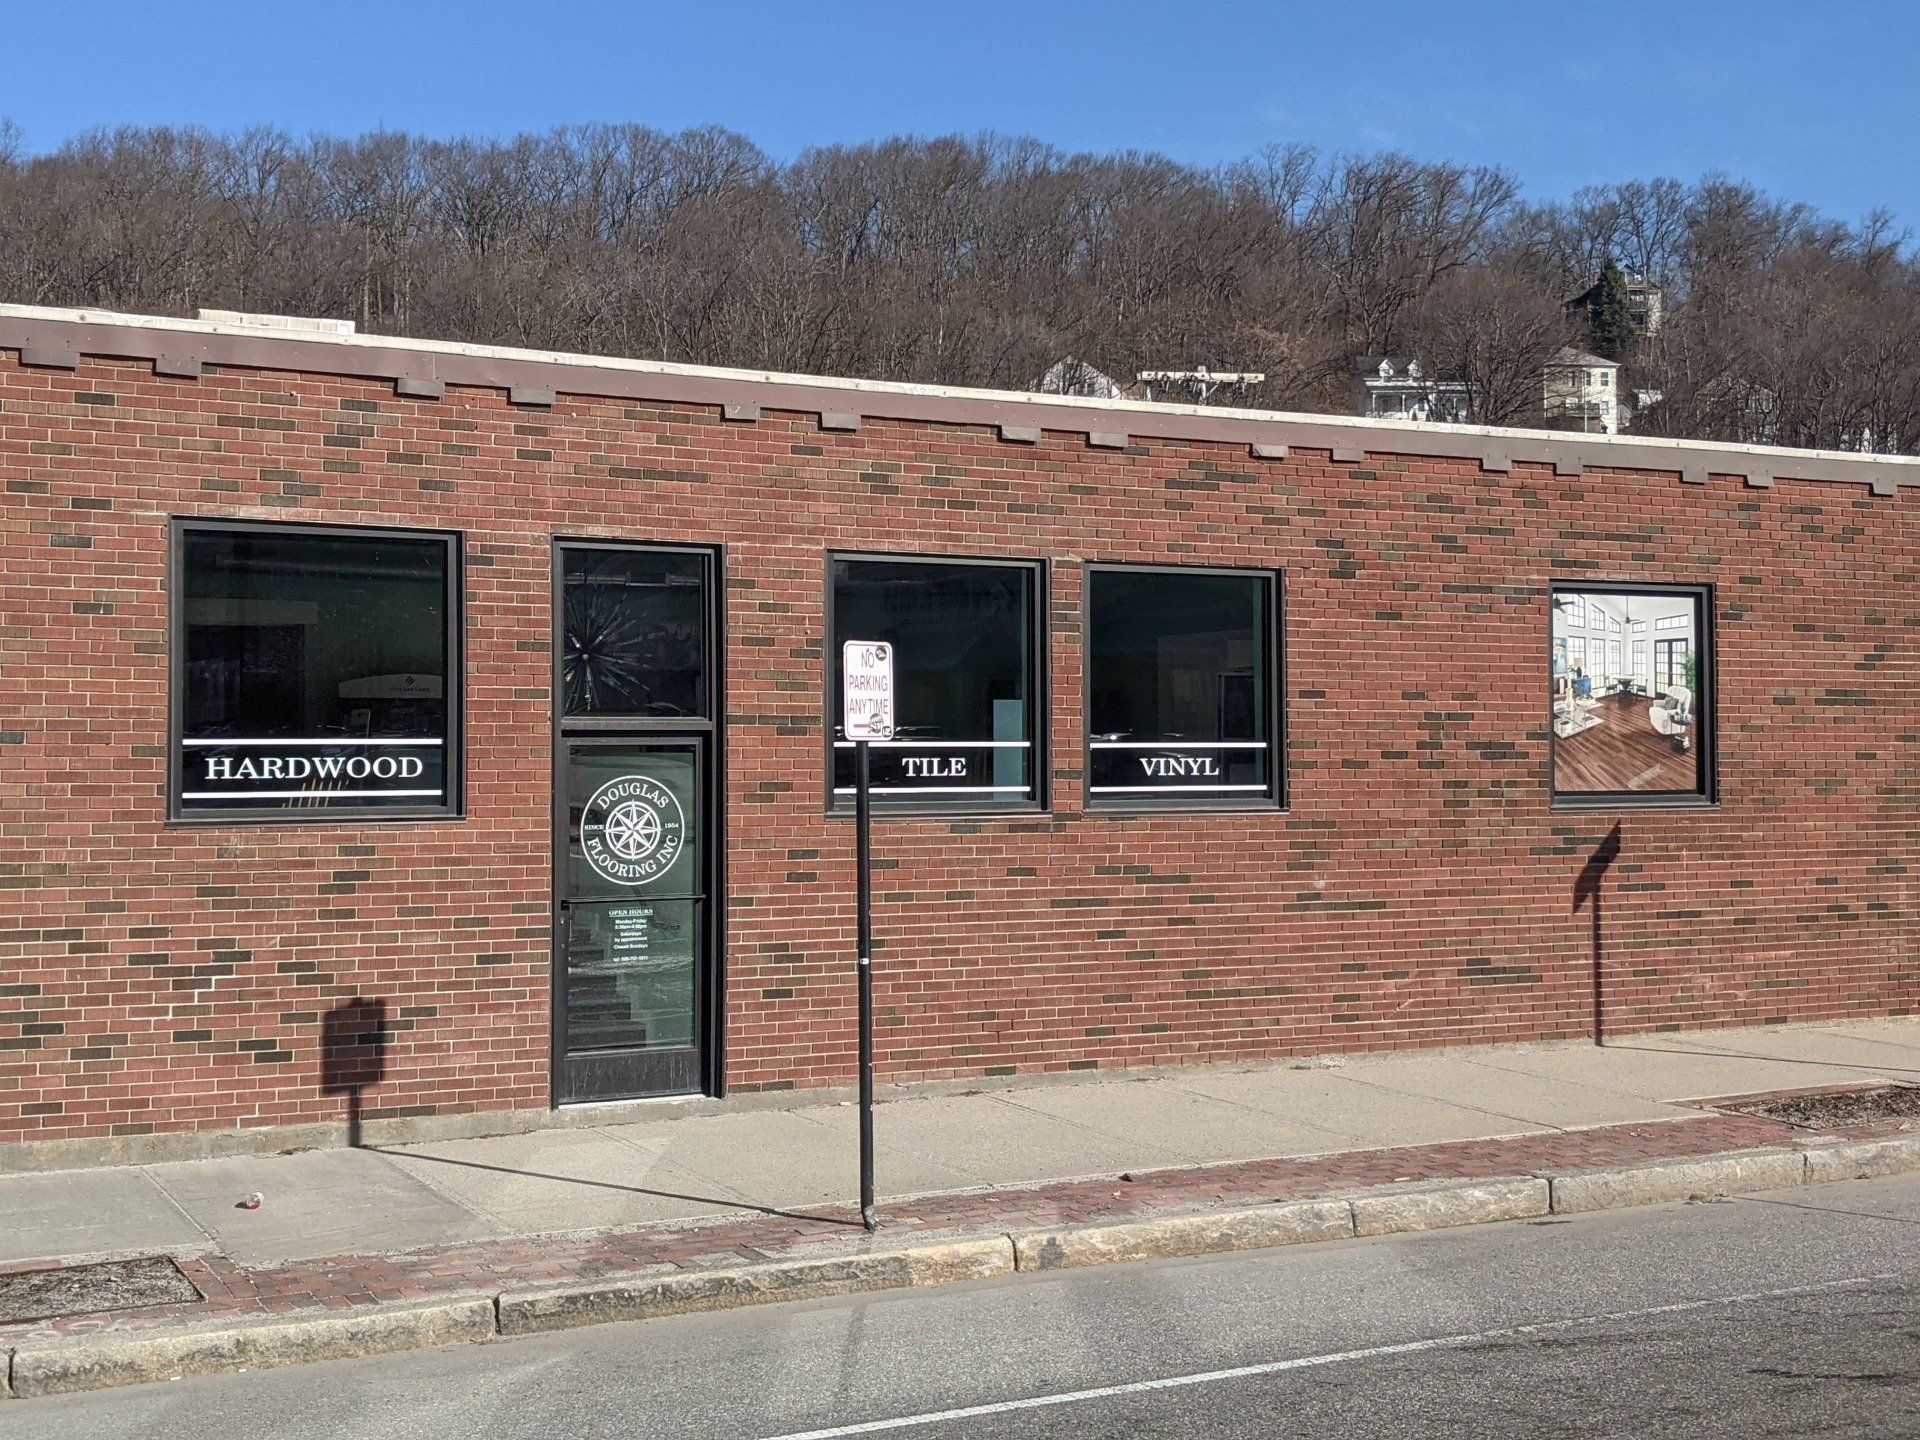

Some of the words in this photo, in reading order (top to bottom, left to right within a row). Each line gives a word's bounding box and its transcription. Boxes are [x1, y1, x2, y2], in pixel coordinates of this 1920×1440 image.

[861, 652, 875, 668] NO
[849, 675, 888, 692] PARKING
[849, 698, 889, 715] ANYTIME
[204, 757, 423, 780] HARDWOOD
[901, 757, 967, 777] TILE
[1140, 757, 1219, 777] VINYL
[597, 783, 669, 809] DOUGLAS
[588, 837, 657, 878] FLOORING
[656, 835, 678, 865] INC
